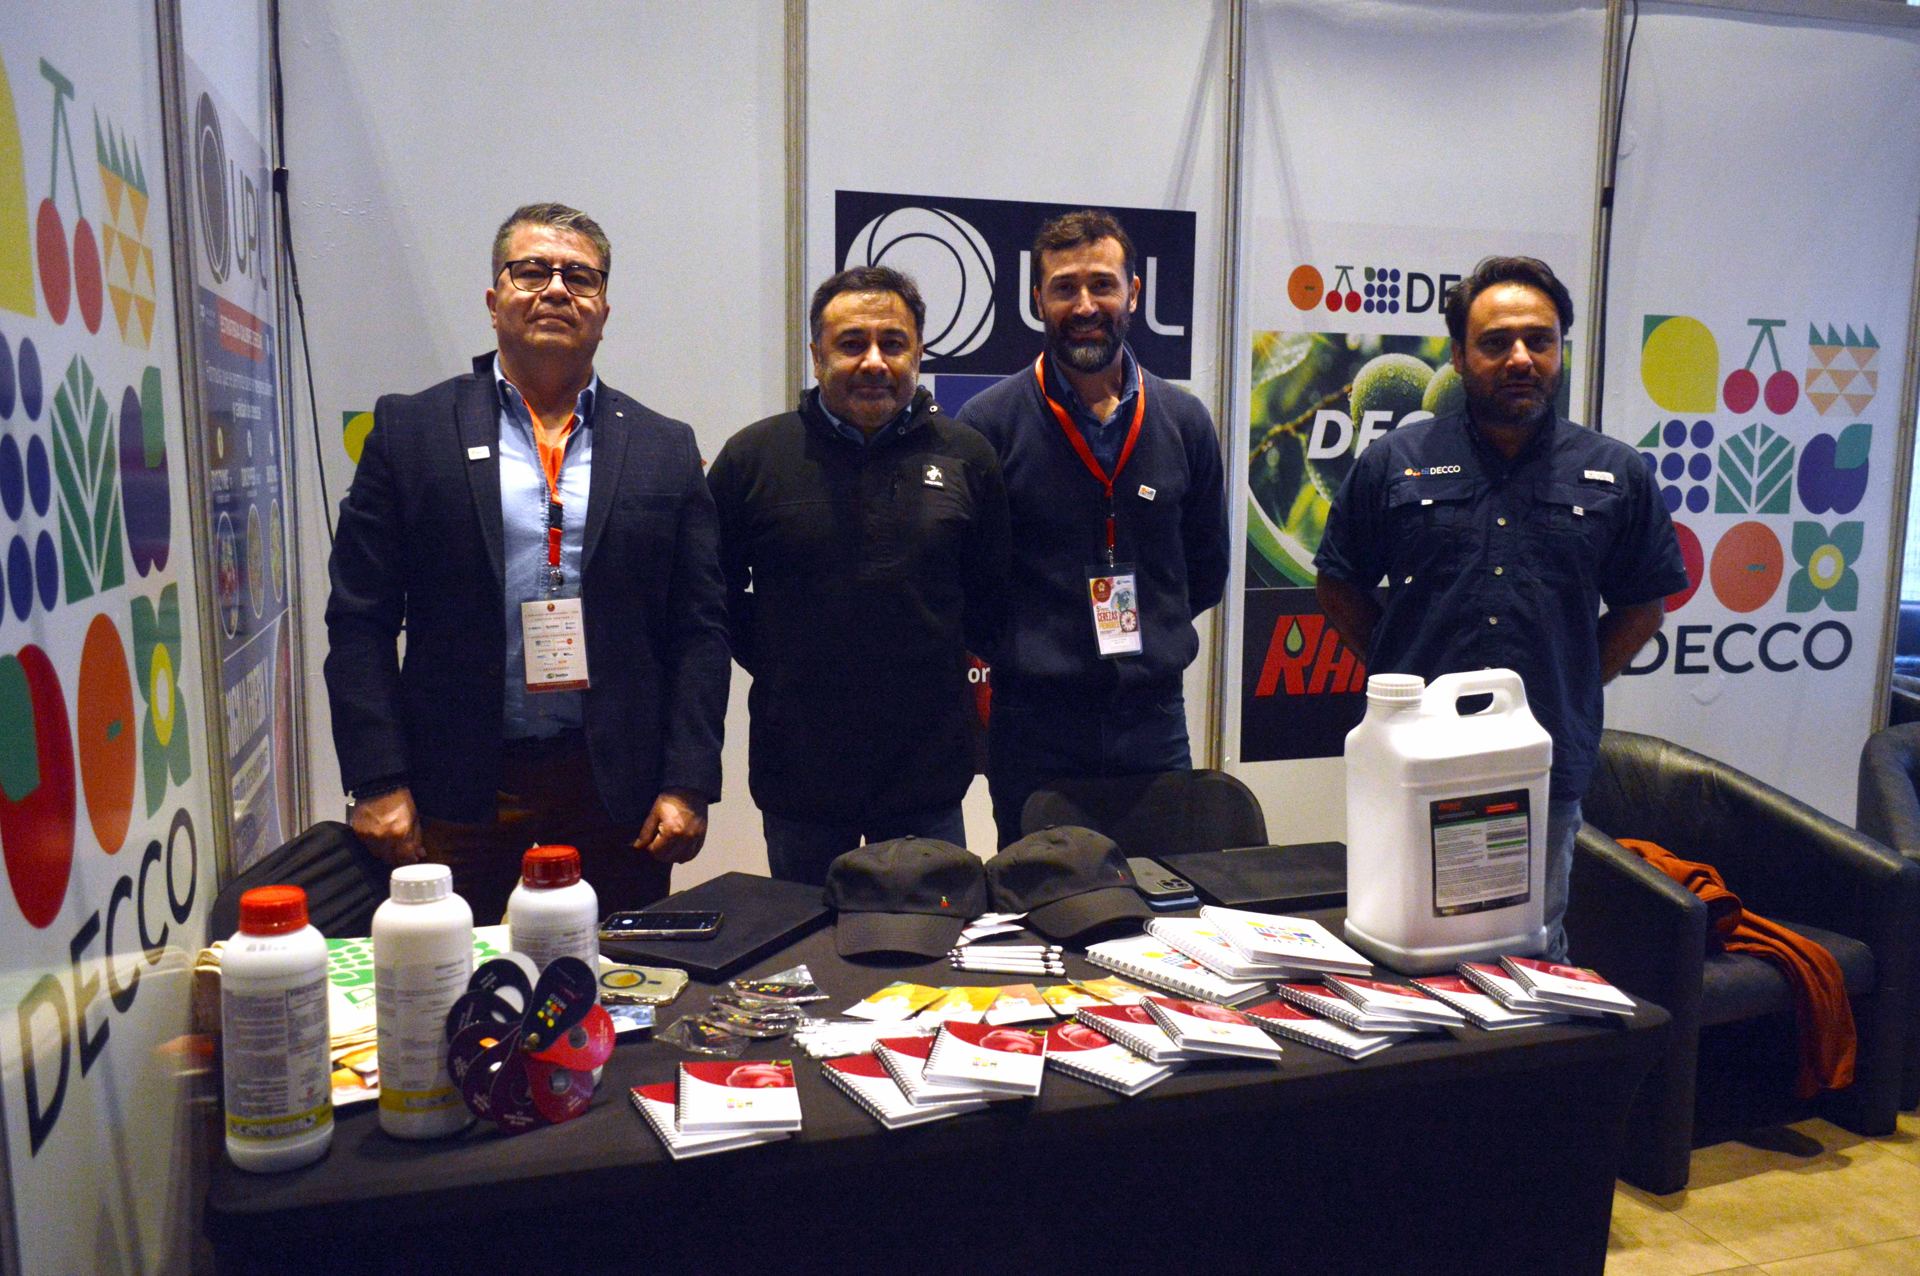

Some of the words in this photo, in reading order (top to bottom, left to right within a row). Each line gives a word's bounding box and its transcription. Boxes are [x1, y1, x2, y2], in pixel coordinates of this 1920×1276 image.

[230, 159, 268, 291] UPL
[1429, 464, 1461, 475] DECCO
[1620, 620, 1853, 676] DECCO
[17, 806, 198, 1159] DECCO
